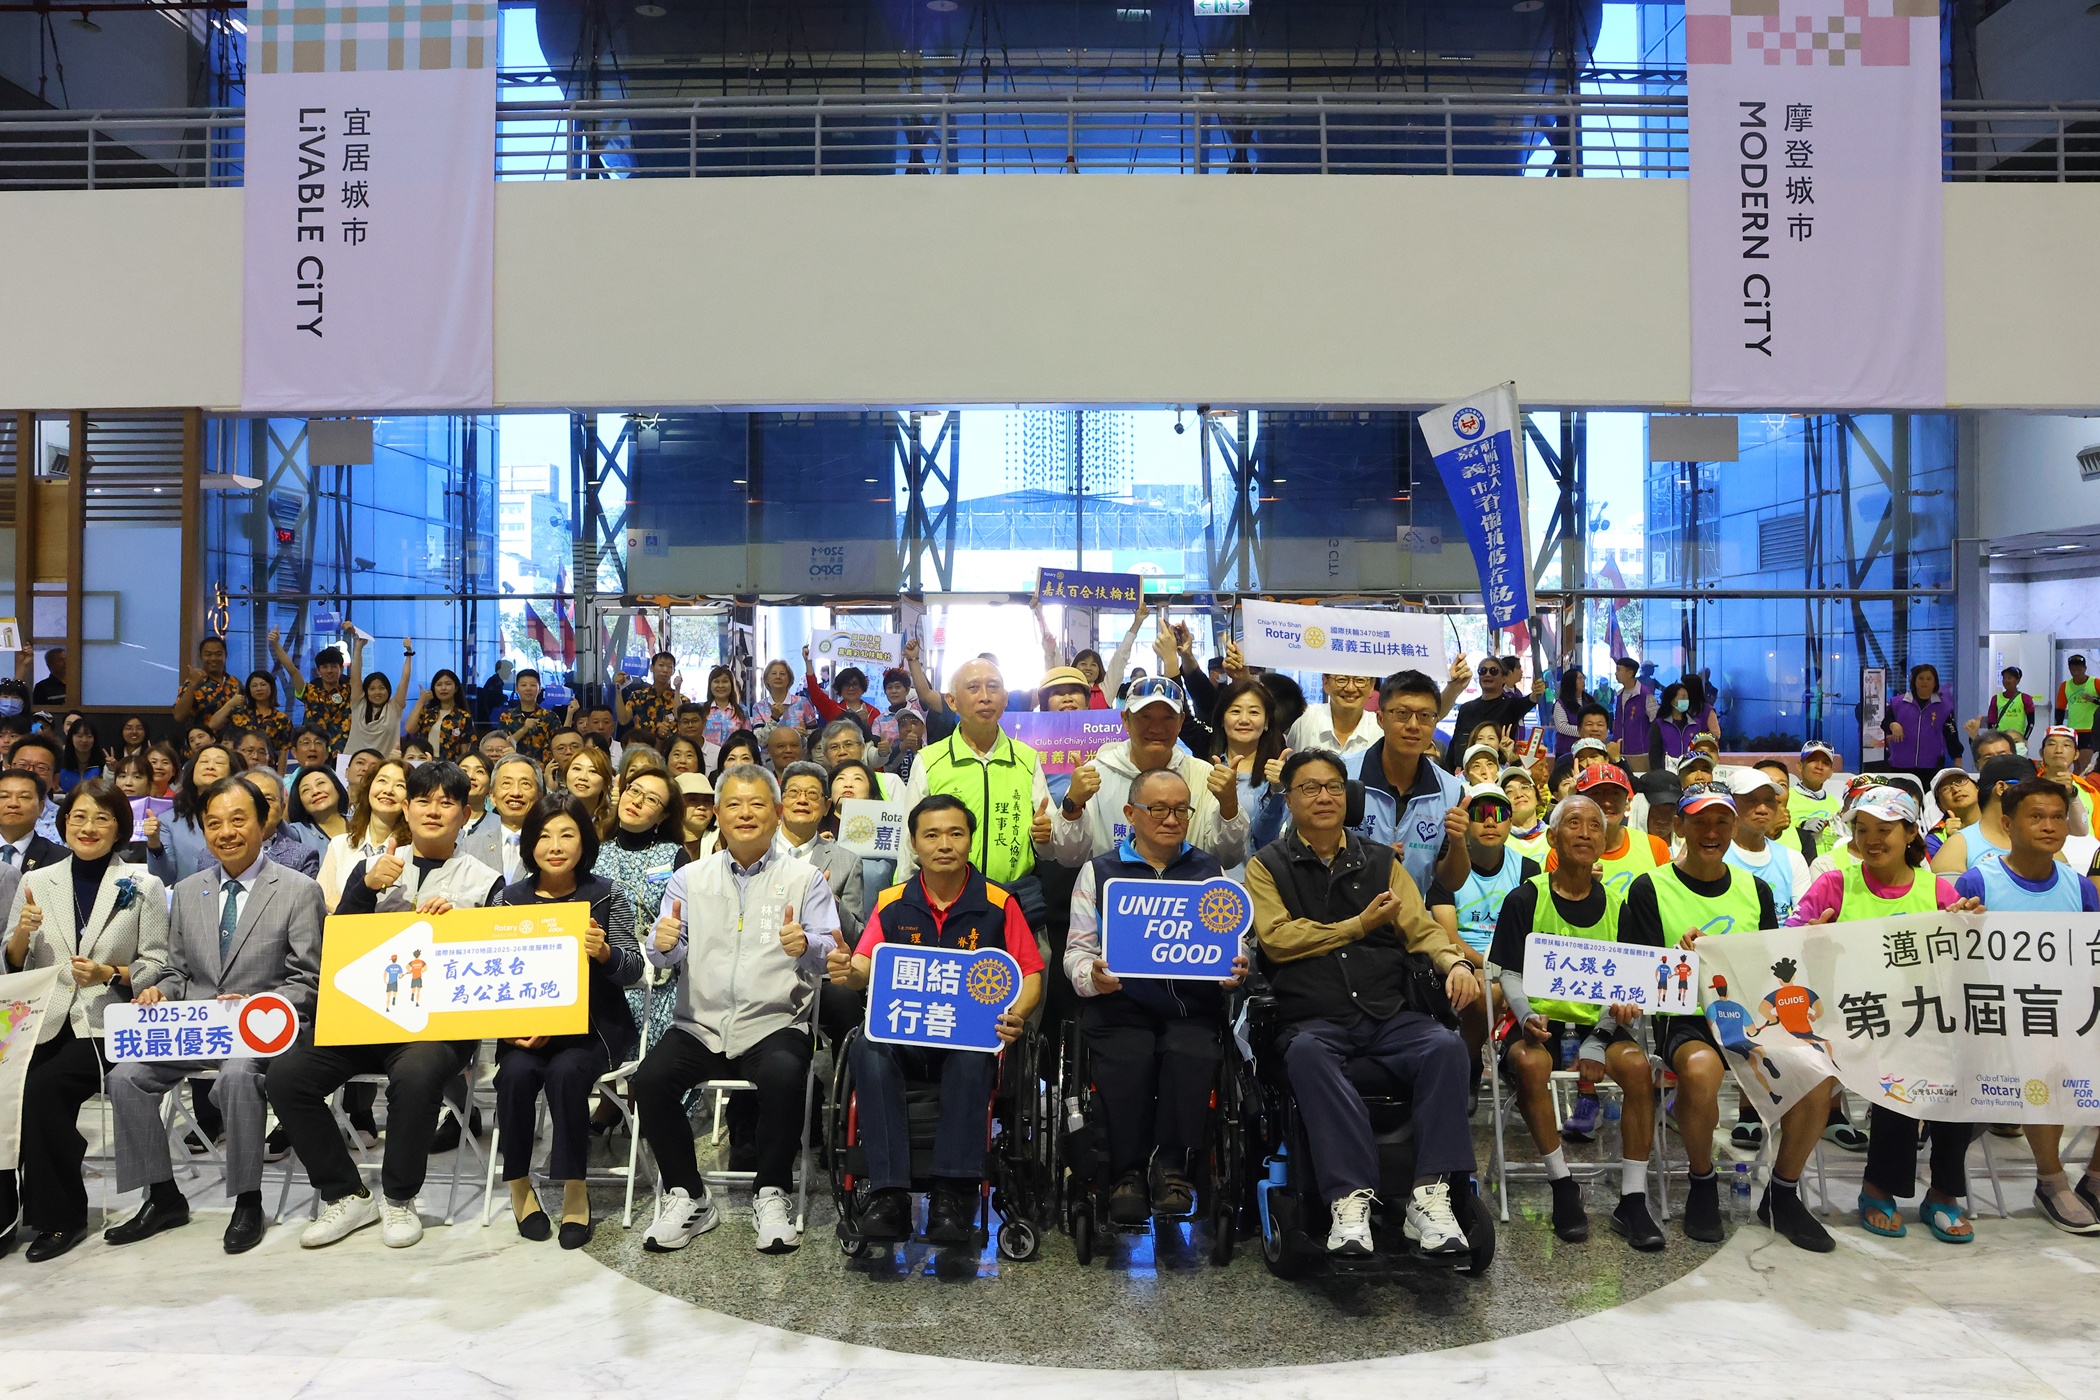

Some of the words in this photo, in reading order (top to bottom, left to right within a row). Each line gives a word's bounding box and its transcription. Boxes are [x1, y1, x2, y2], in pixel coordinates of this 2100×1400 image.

[341, 107, 371, 246] 宜居城市
[1739, 102, 1769, 259] MODERN
[1784, 103, 1815, 242] 摩登城市
[1042, 580, 1136, 601] 嘉義百合扶輪社
[1257, 619, 1278, 627] Chia-Yi
[1287, 621, 1301, 629] Shan
[1330, 626, 1390, 639] 國際扶輪3470地區
[1265, 627, 1301, 642] Rotary
[1288, 642, 1301, 650] Club
[1330, 638, 1429, 658] 嘉義玉山扶輪社
[1083, 723, 1122, 735] Rotary
[1054, 737, 1063, 745] of
[1063, 736, 1087, 746] Chiayi
[1088, 736, 1122, 744] Sunshine
[994, 802, 1009, 847] 理事長
[1009, 789, 1021, 868] 嘉義市盲人協會
[1117, 895, 1189, 917] UNITE
[1471, 910, 1501, 922] 盲人
[494, 924, 518, 933] Rotary
[760, 904, 773, 944] 林瑞彥
[1144, 919, 1193, 940] FOR
[1151, 942, 1223, 965] GOOD
[443, 956, 525, 980] 盲人環台
[1543, 951, 1617, 977] 盲人環台
[891, 955, 962, 995] 團結
[451, 980, 560, 1004] 為公益而跑
[1549, 976, 1647, 1005] 為公益而跑
[1777, 995, 1805, 1006] GUIDE
[138, 1006, 208, 1023] 2025-26
[886, 998, 957, 1039] 行善
[1718, 1010, 1741, 1019] BLIND
[114, 1025, 234, 1059] 我最優秀
[1976, 1074, 1991, 1082] Club
[2000, 1075, 2020, 1084] Taipei
[2062, 1079, 2090, 1088] UNITE
[1981, 1083, 2021, 1098] Rotary
[2073, 1089, 2093, 1098] FOR
[1970, 1097, 1994, 1107] Charity
[1995, 1098, 2023, 1109] Running
[2076, 1098, 2100, 1108] GOO
